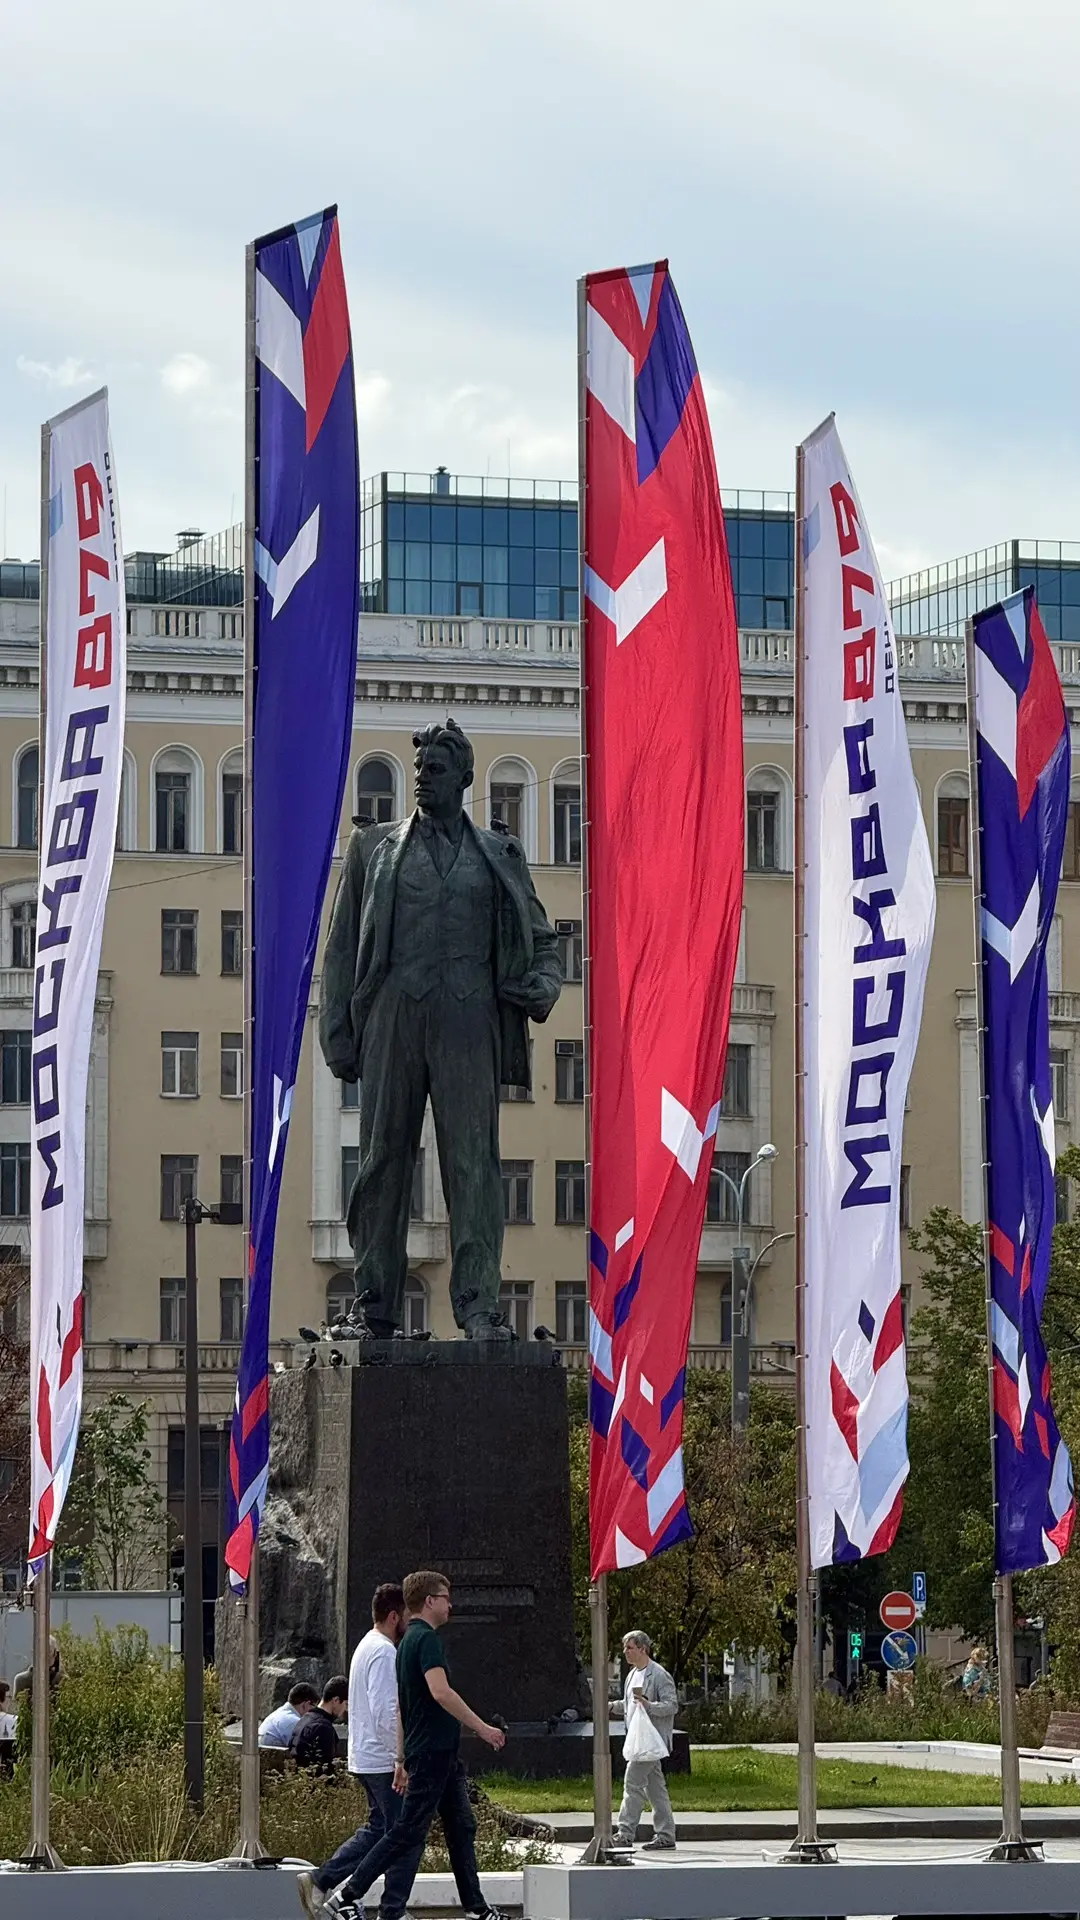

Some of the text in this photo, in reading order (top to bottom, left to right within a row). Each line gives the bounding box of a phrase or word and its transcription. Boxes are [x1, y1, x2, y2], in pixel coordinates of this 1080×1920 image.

[32, 461, 112, 1211] МОСКВА 879
[829, 480, 906, 1210] МОСКВА 879
[916, 1575, 923, 1599] P
